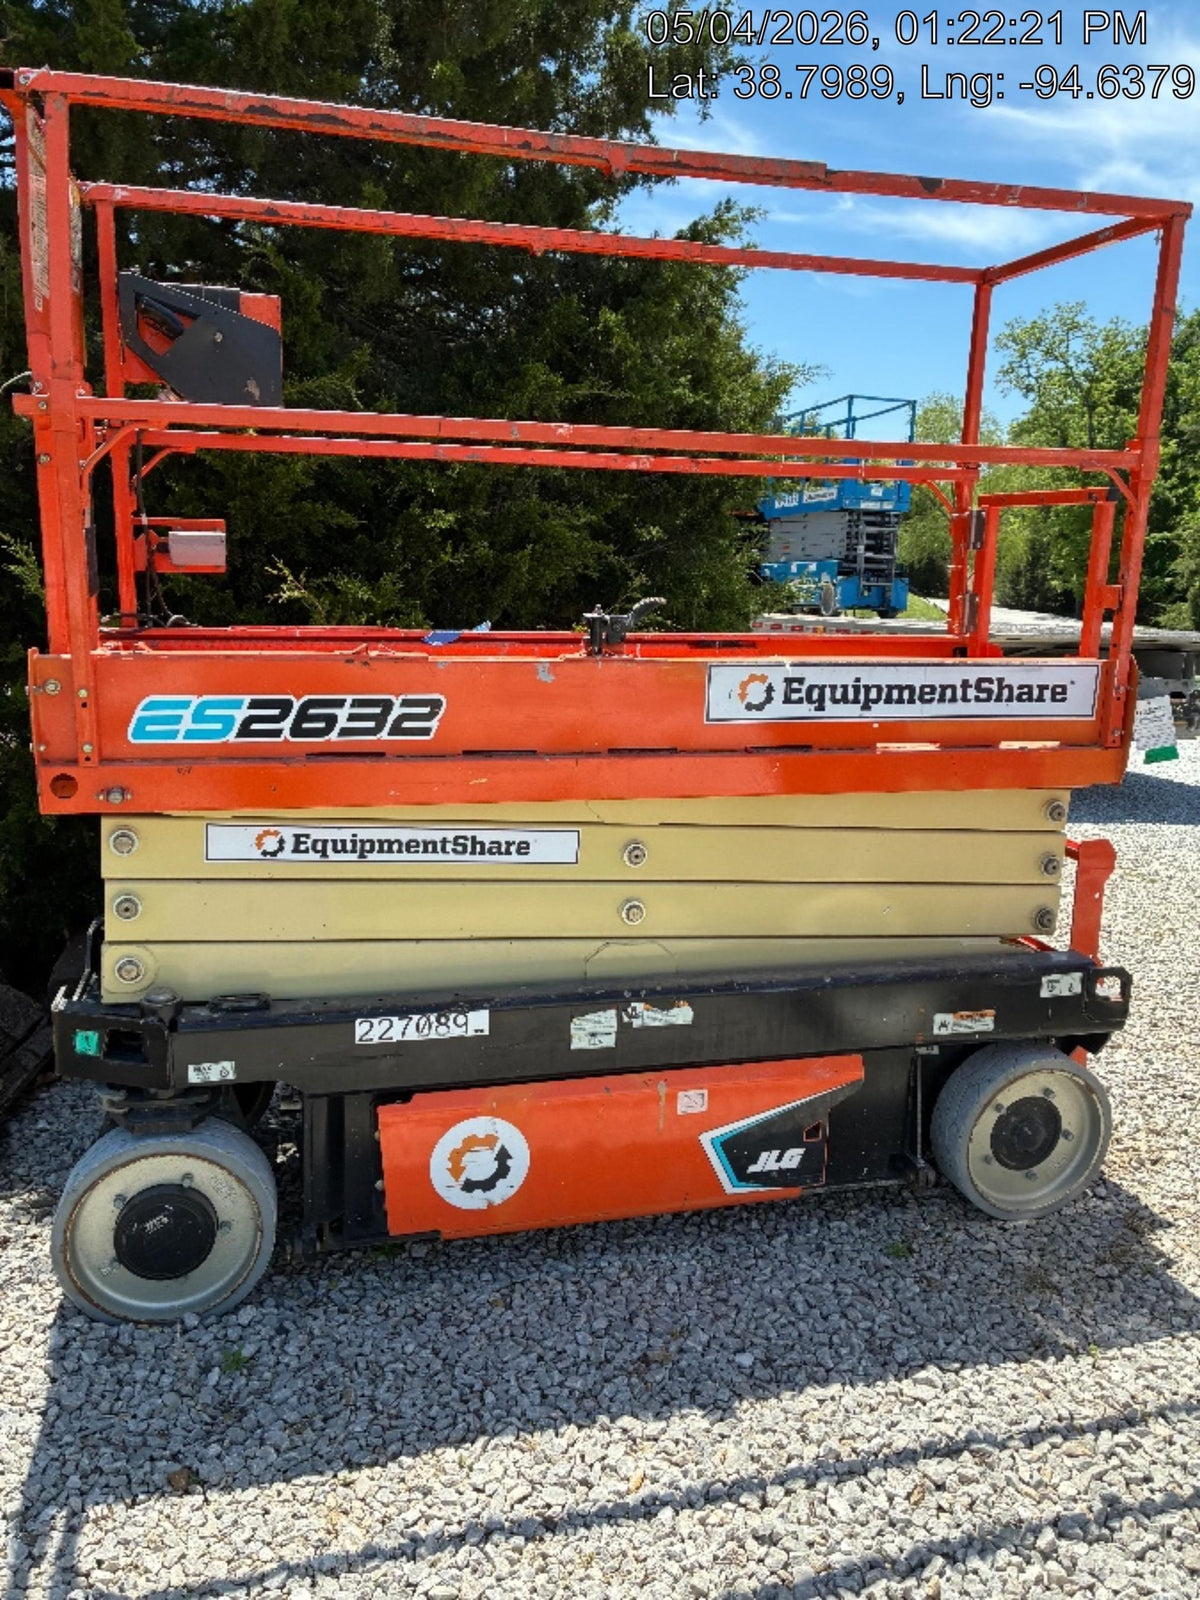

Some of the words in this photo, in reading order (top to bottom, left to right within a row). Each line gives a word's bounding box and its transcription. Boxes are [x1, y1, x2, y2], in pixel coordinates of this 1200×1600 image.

[782, 677, 1069, 712] EquipmentShare
[130, 696, 445, 742] ES2632
[291, 832, 531, 859] EquipmentShare
[746, 1147, 806, 1174] JLG
